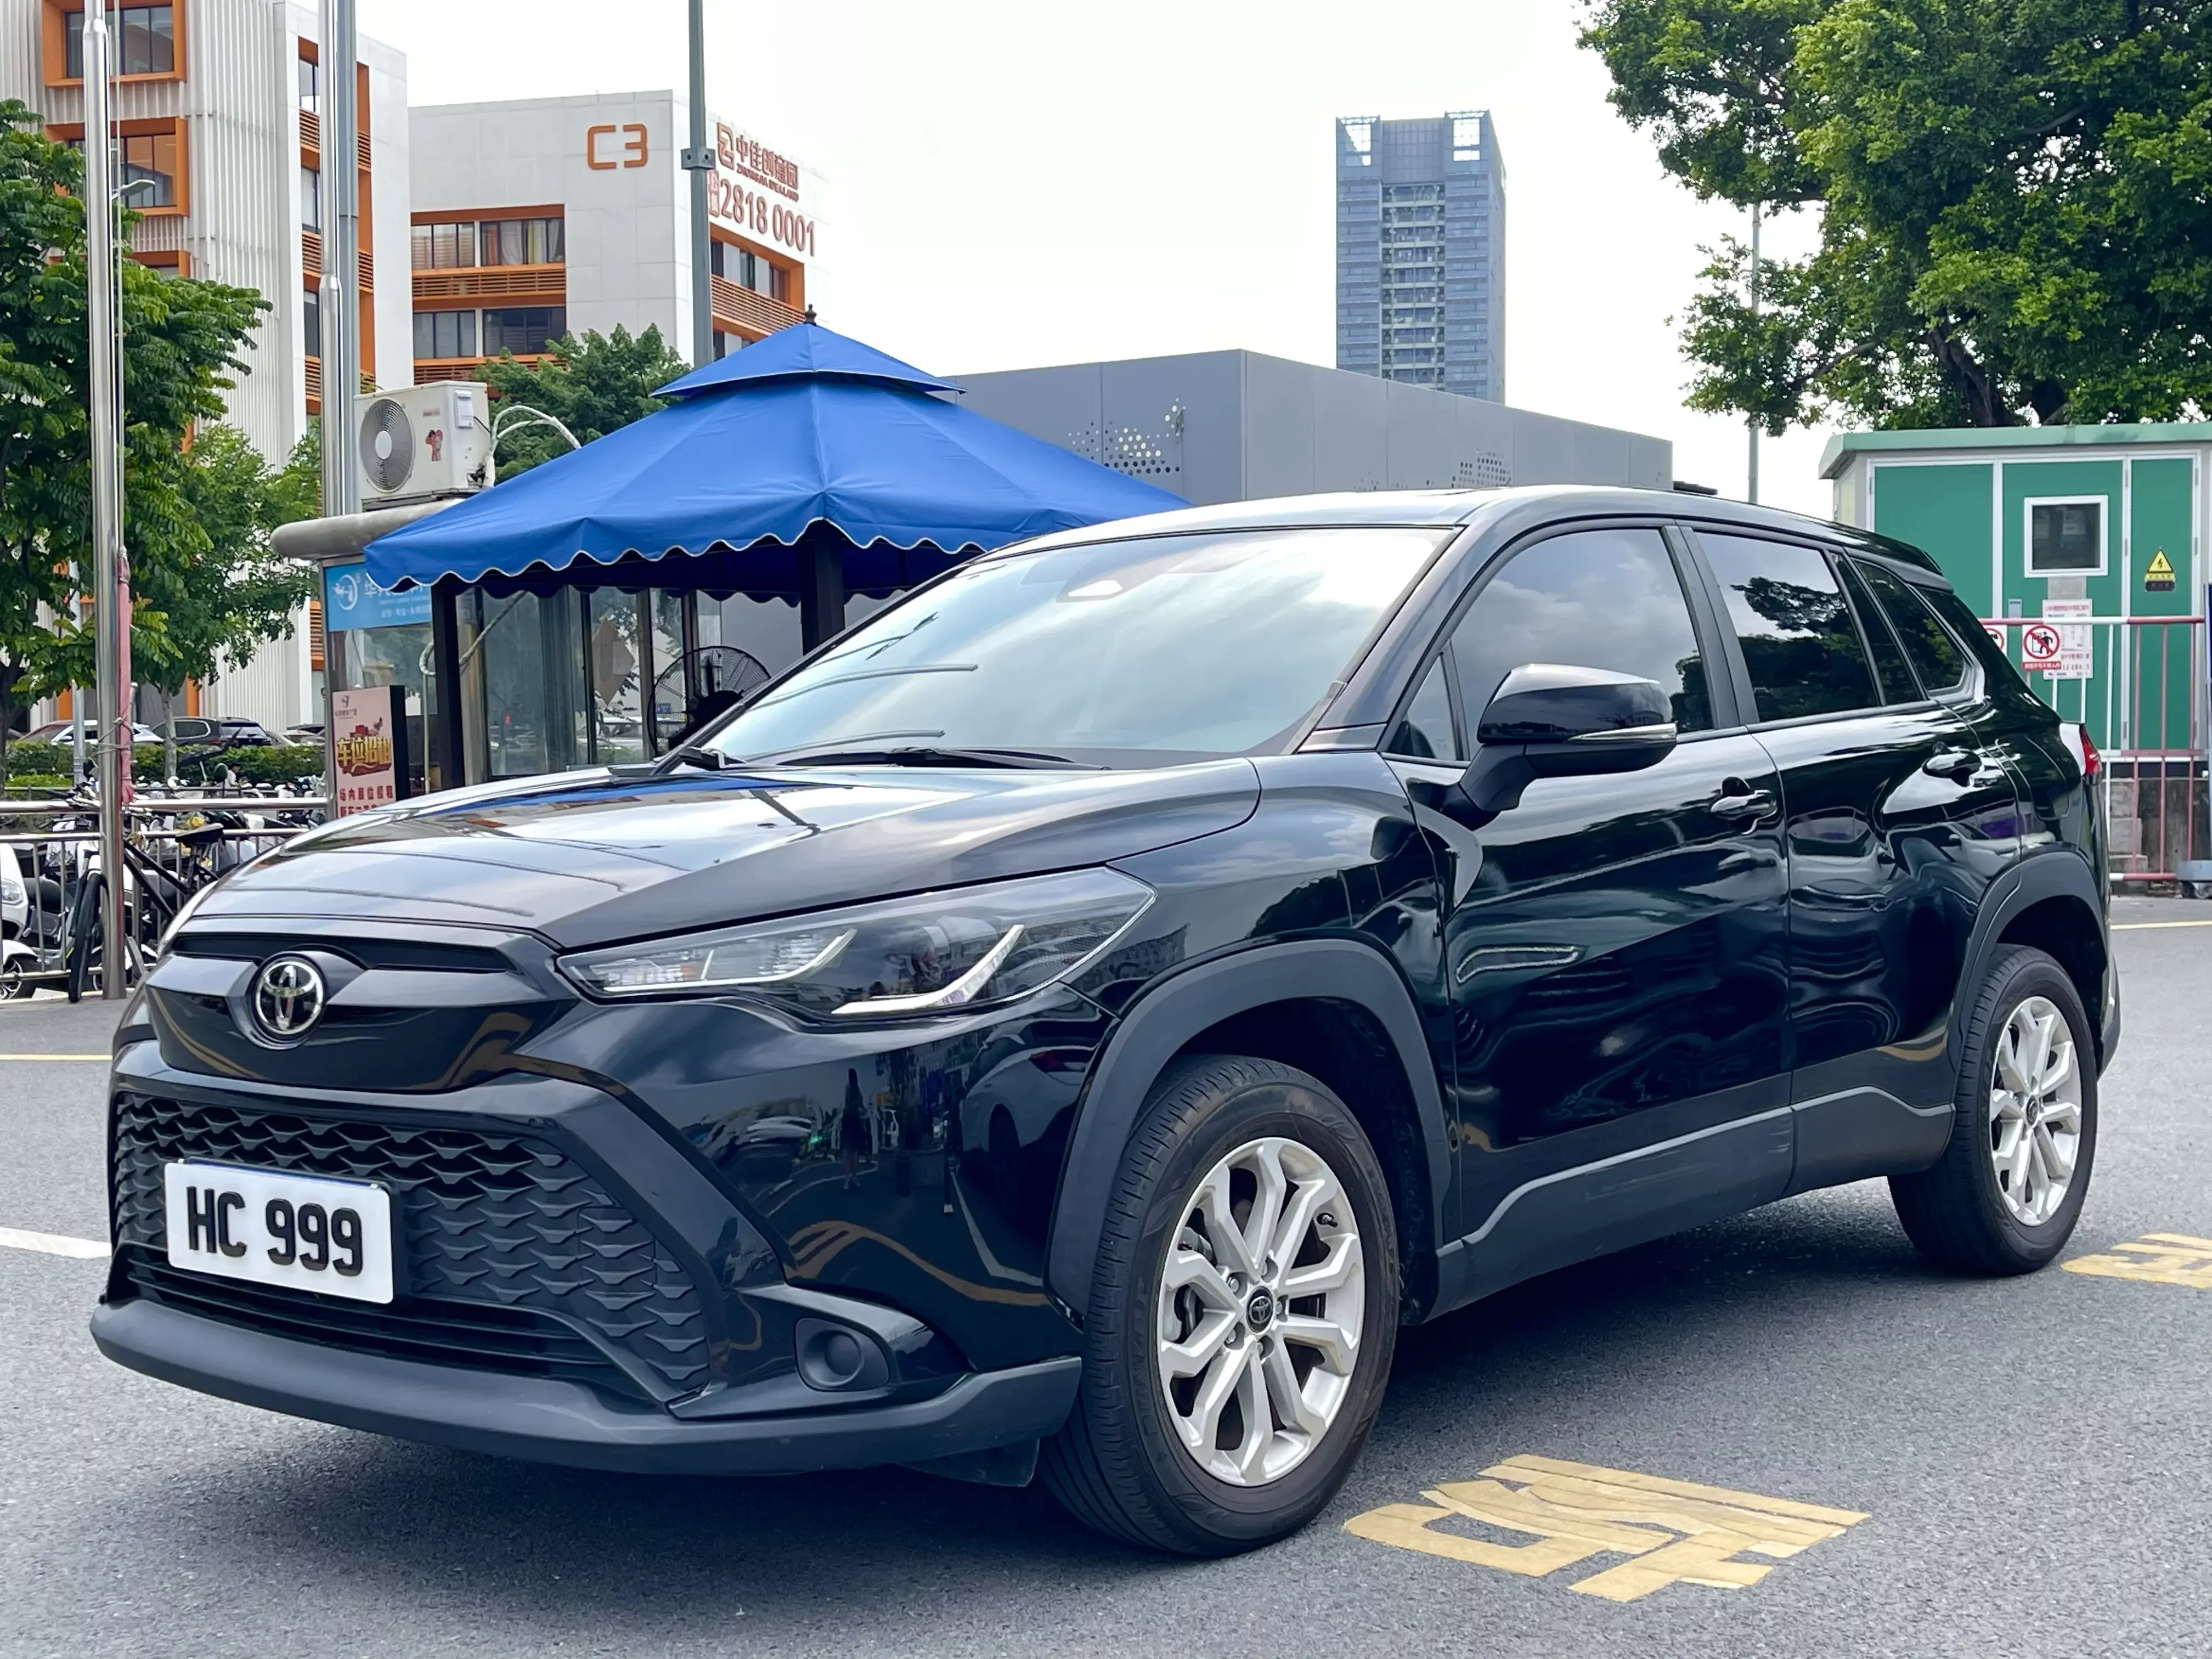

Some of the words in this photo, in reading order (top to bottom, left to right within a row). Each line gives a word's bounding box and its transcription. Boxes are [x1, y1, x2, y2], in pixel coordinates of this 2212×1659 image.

[588, 123, 647, 170] C3
[720, 178, 768, 234] 2818
[772, 204, 815, 257] 0001
[337, 736, 392, 767] 车位招租
[187, 1186, 247, 1257] HC
[266, 1198, 363, 1277] 999
